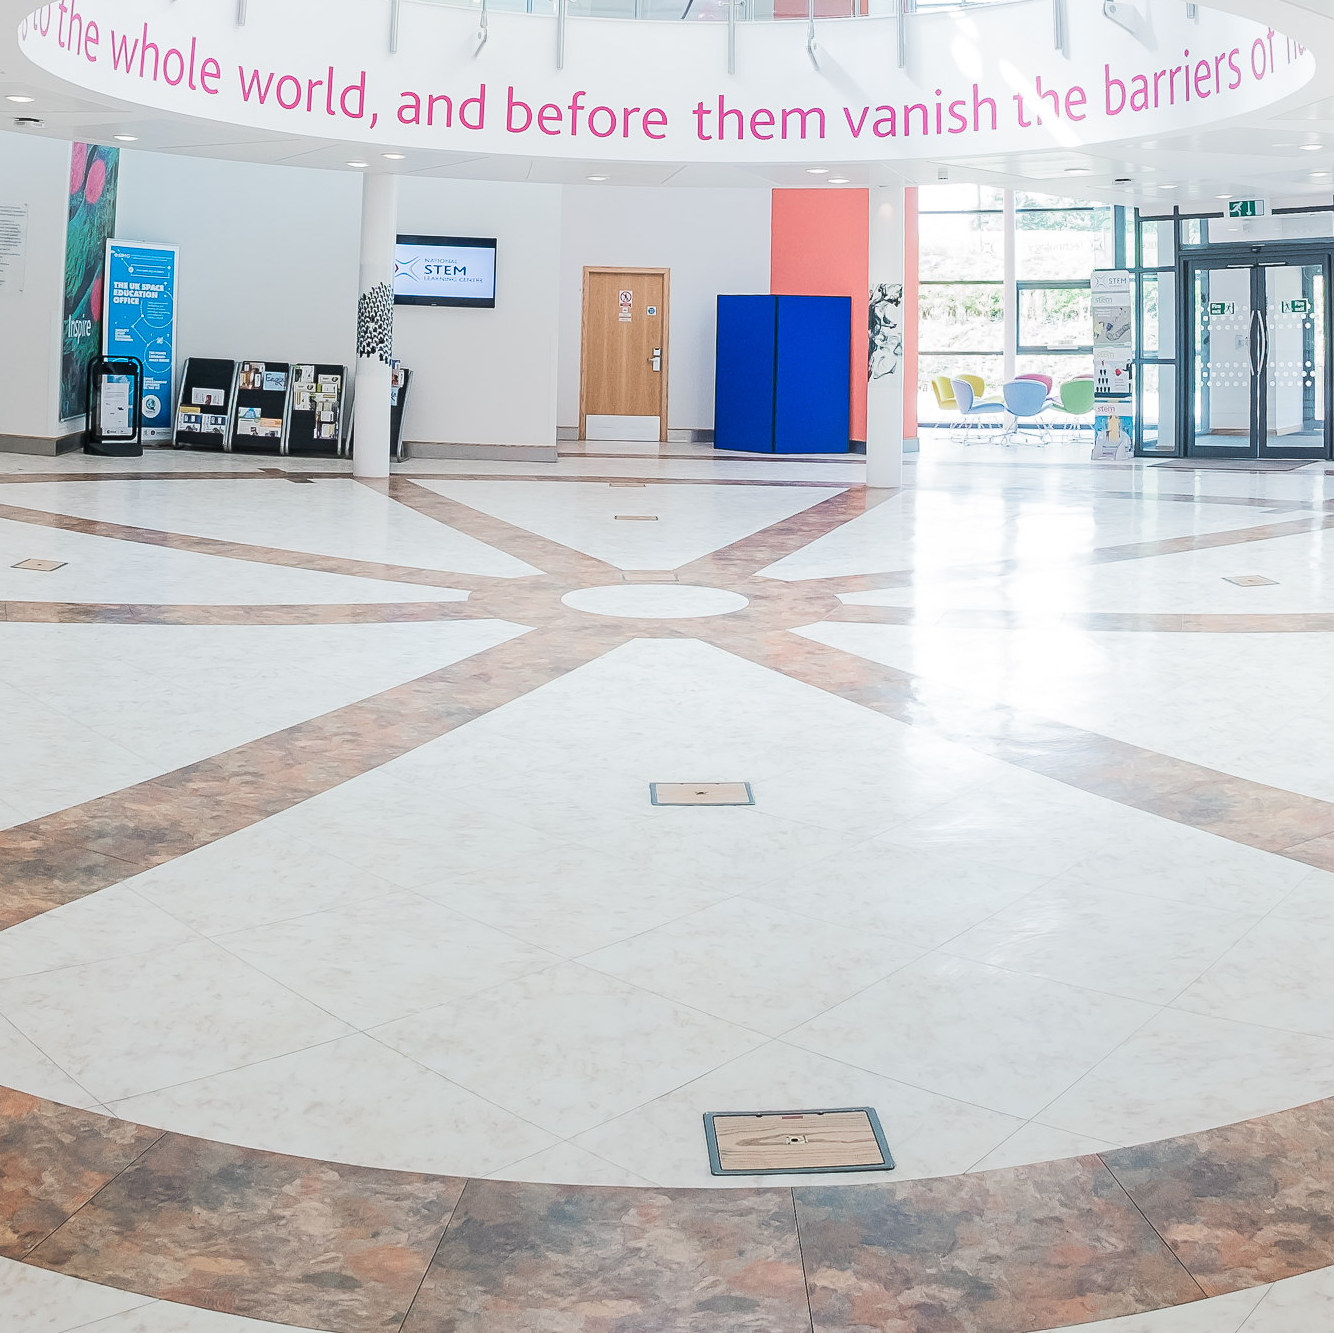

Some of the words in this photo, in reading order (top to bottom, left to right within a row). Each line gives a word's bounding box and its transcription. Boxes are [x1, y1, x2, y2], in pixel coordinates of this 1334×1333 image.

[111, 22, 220, 95] whole
[238, 66, 378, 130] world,
[397, 84, 486, 131] and
[506, 86, 667, 139] before
[692, 95, 825, 141] them
[842, 84, 997, 138] vanish
[1013, 75, 1087, 129] the
[1105, 49, 1242, 116] barriers
[424, 264, 467, 276] STEM
[113, 281, 128, 289] THE
[129, 282, 140, 290] UK
[141, 283, 165, 292] SPACE
[113, 289, 158, 299] EDUCATION
[113, 297, 140, 305] OFFICE
[68, 314, 92, 345] Inspire
[1097, 405, 1115, 413] stem
